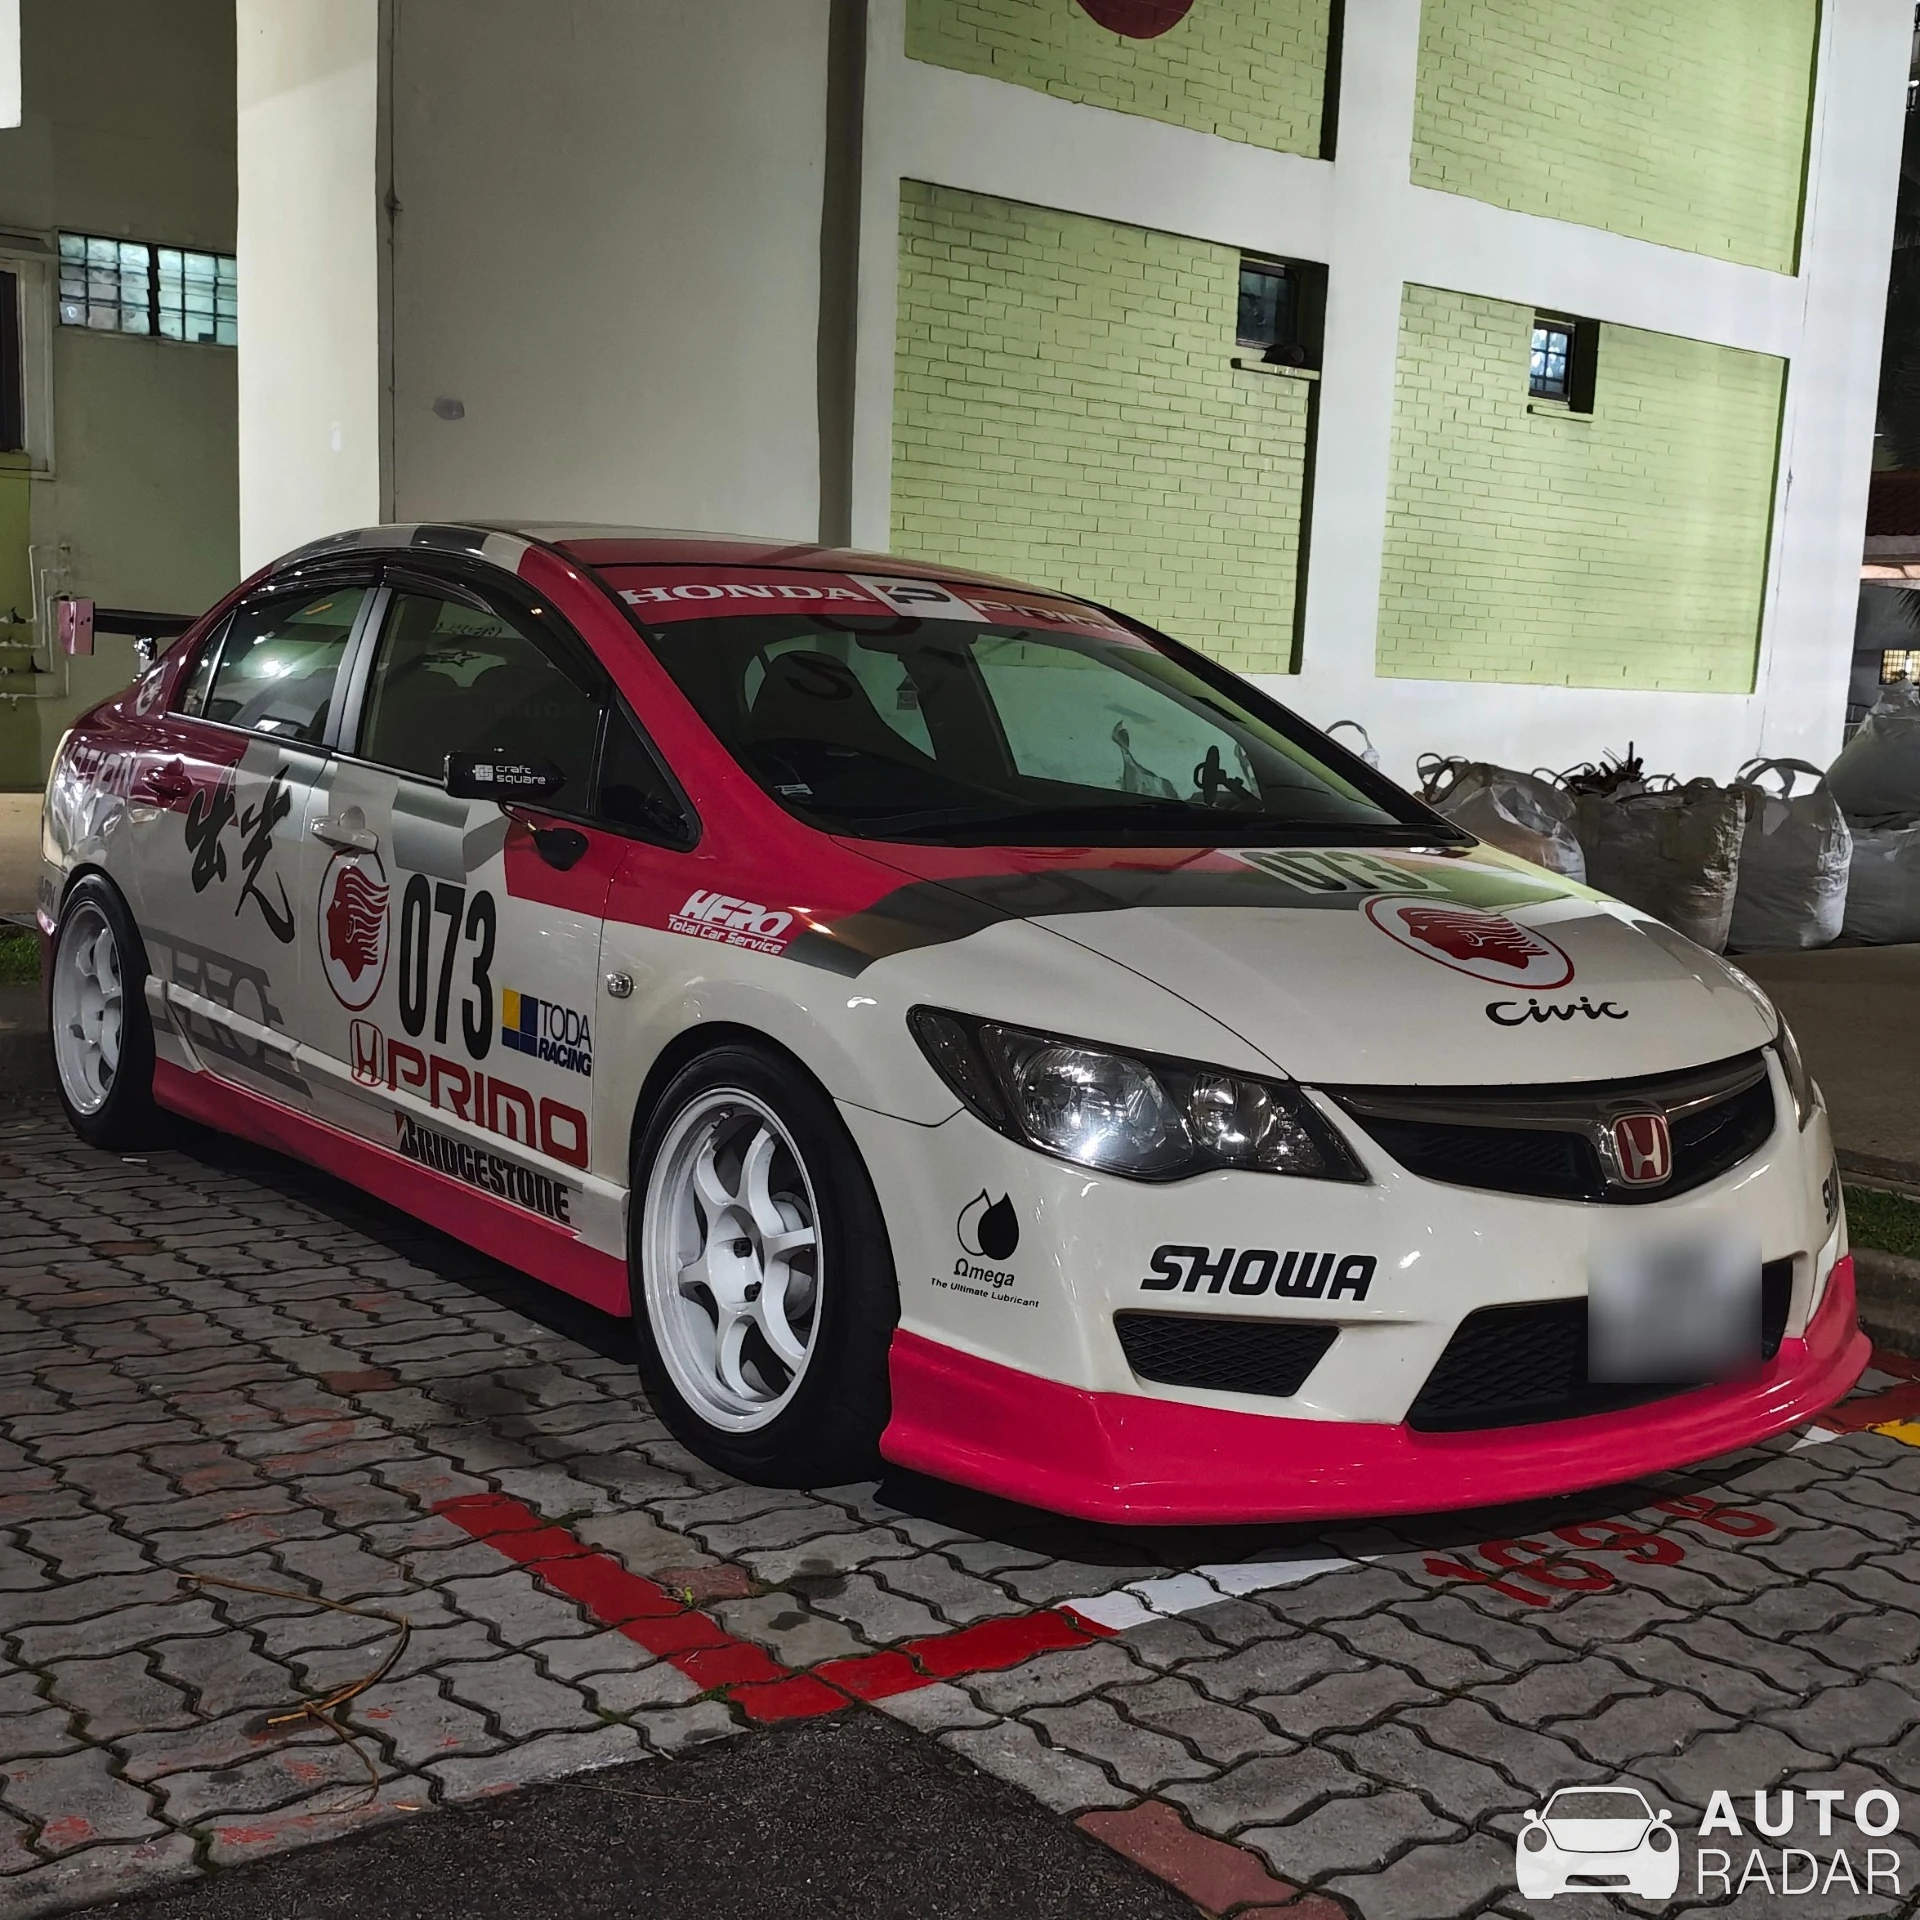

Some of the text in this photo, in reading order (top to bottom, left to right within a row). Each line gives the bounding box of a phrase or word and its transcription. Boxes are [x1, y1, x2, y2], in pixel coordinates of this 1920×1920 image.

[617, 584, 877, 605] HONDA
[496, 765, 531, 774] craft
[496, 775, 546, 785] square
[1240, 851, 1428, 892] 073
[679, 889, 793, 937] HERO
[668, 918, 783, 954] Total Car Service
[400, 873, 496, 1060] 073
[539, 999, 592, 1052] TODA
[1485, 997, 1629, 1026] Civic
[538, 1037, 591, 1077] RACING
[387, 1038, 588, 1169] PRIMO
[394, 1109, 571, 1224] BRIDGESTONE
[931, 1277, 1040, 1308] The Ultimate Lubricant
[1140, 1245, 1377, 1301] SHOWA
